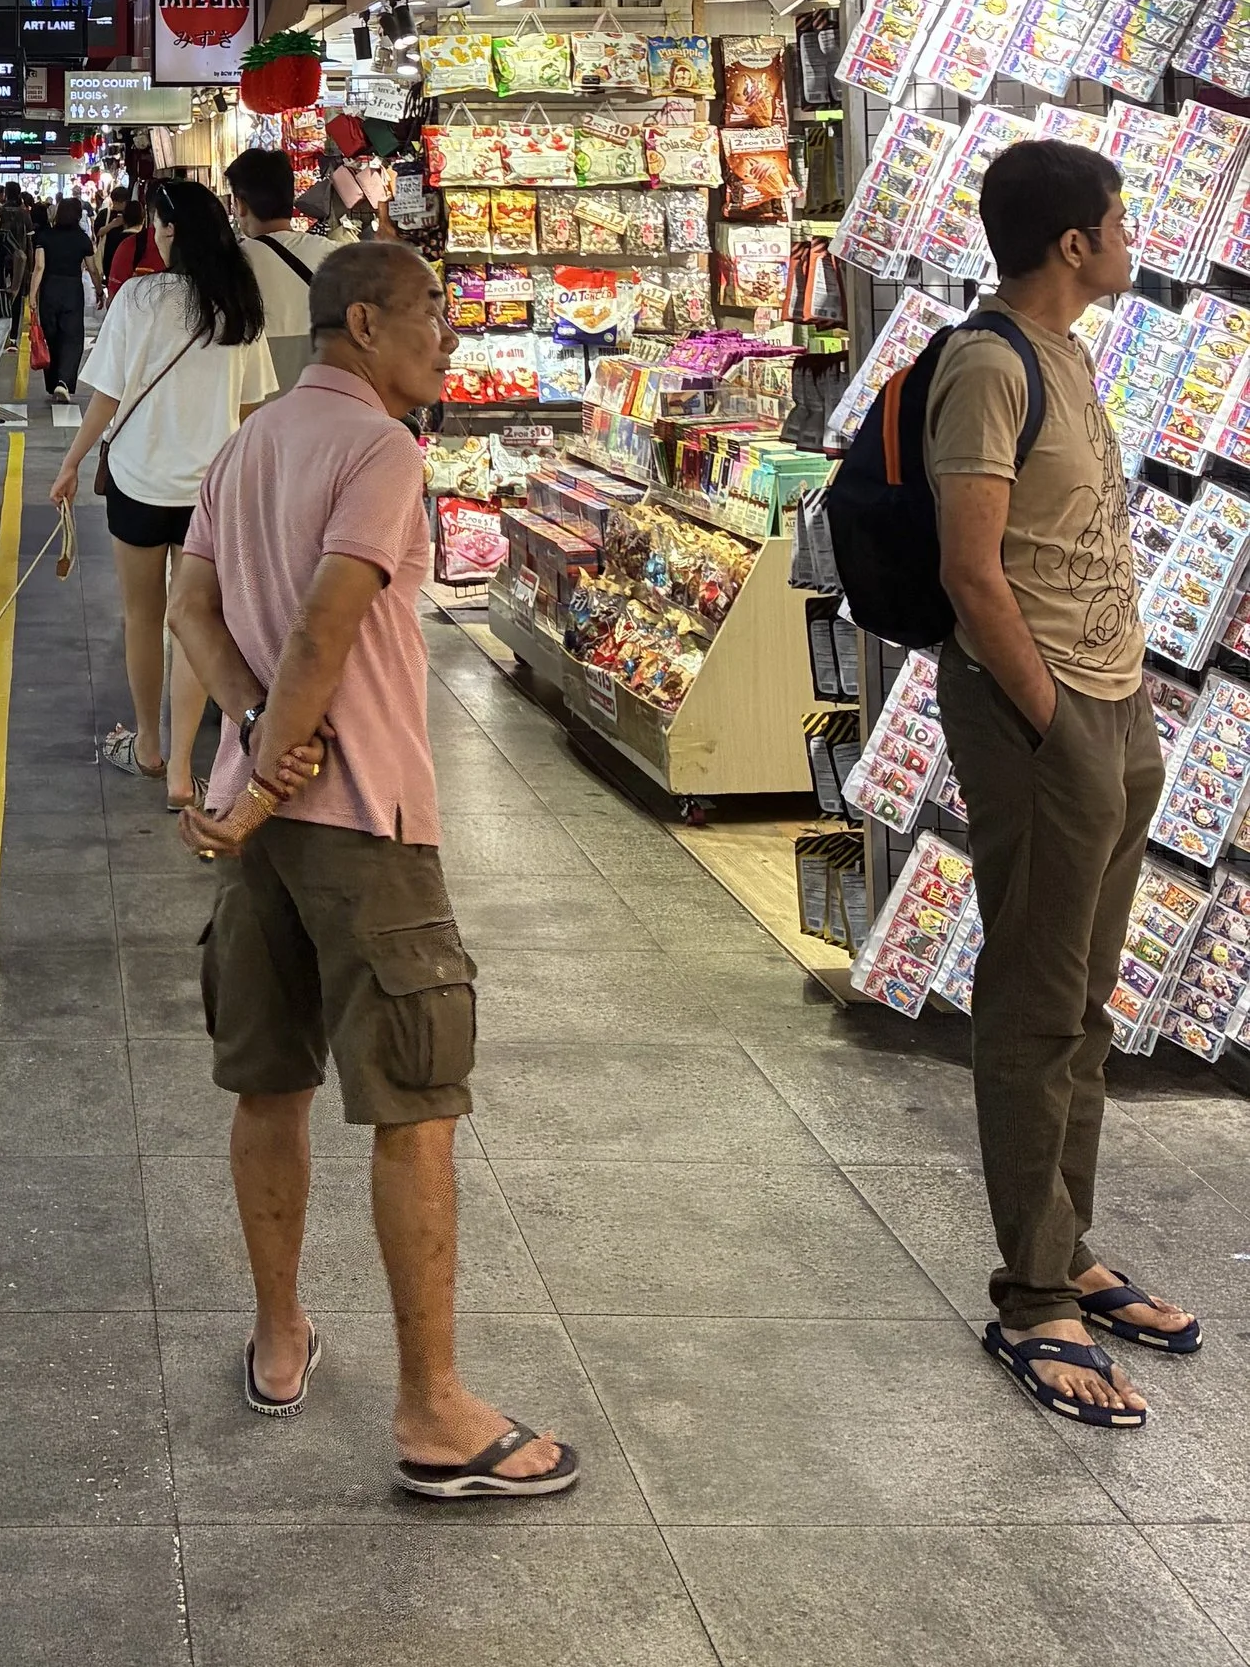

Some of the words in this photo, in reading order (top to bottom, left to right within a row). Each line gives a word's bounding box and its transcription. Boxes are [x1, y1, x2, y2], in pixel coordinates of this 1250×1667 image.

[23, 20, 45, 31] ART
[47, 20, 76, 31] LANE
[173, 30, 234, 49] みずき
[656, 47, 705, 62] Pineapple
[70, 77, 100, 89] FOOD
[102, 77, 140, 89] COURT
[70, 91, 108, 101] BUGIS+
[583, 115, 594, 126] 2
[608, 124, 631, 139] $10
[659, 139, 680, 153] Chia
[680, 140, 703, 152] Seed
[734, 138, 744, 147] 2
[760, 138, 782, 146] $10
[580, 199, 589, 210] 2
[604, 211, 626, 226] $12
[485, 282, 494, 293] 2
[510, 280, 532, 293] $10
[558, 290, 586, 304] OAT
[463, 351, 487, 362] $10
[503, 427, 514, 438] 2
[458, 510, 469, 522] 2
